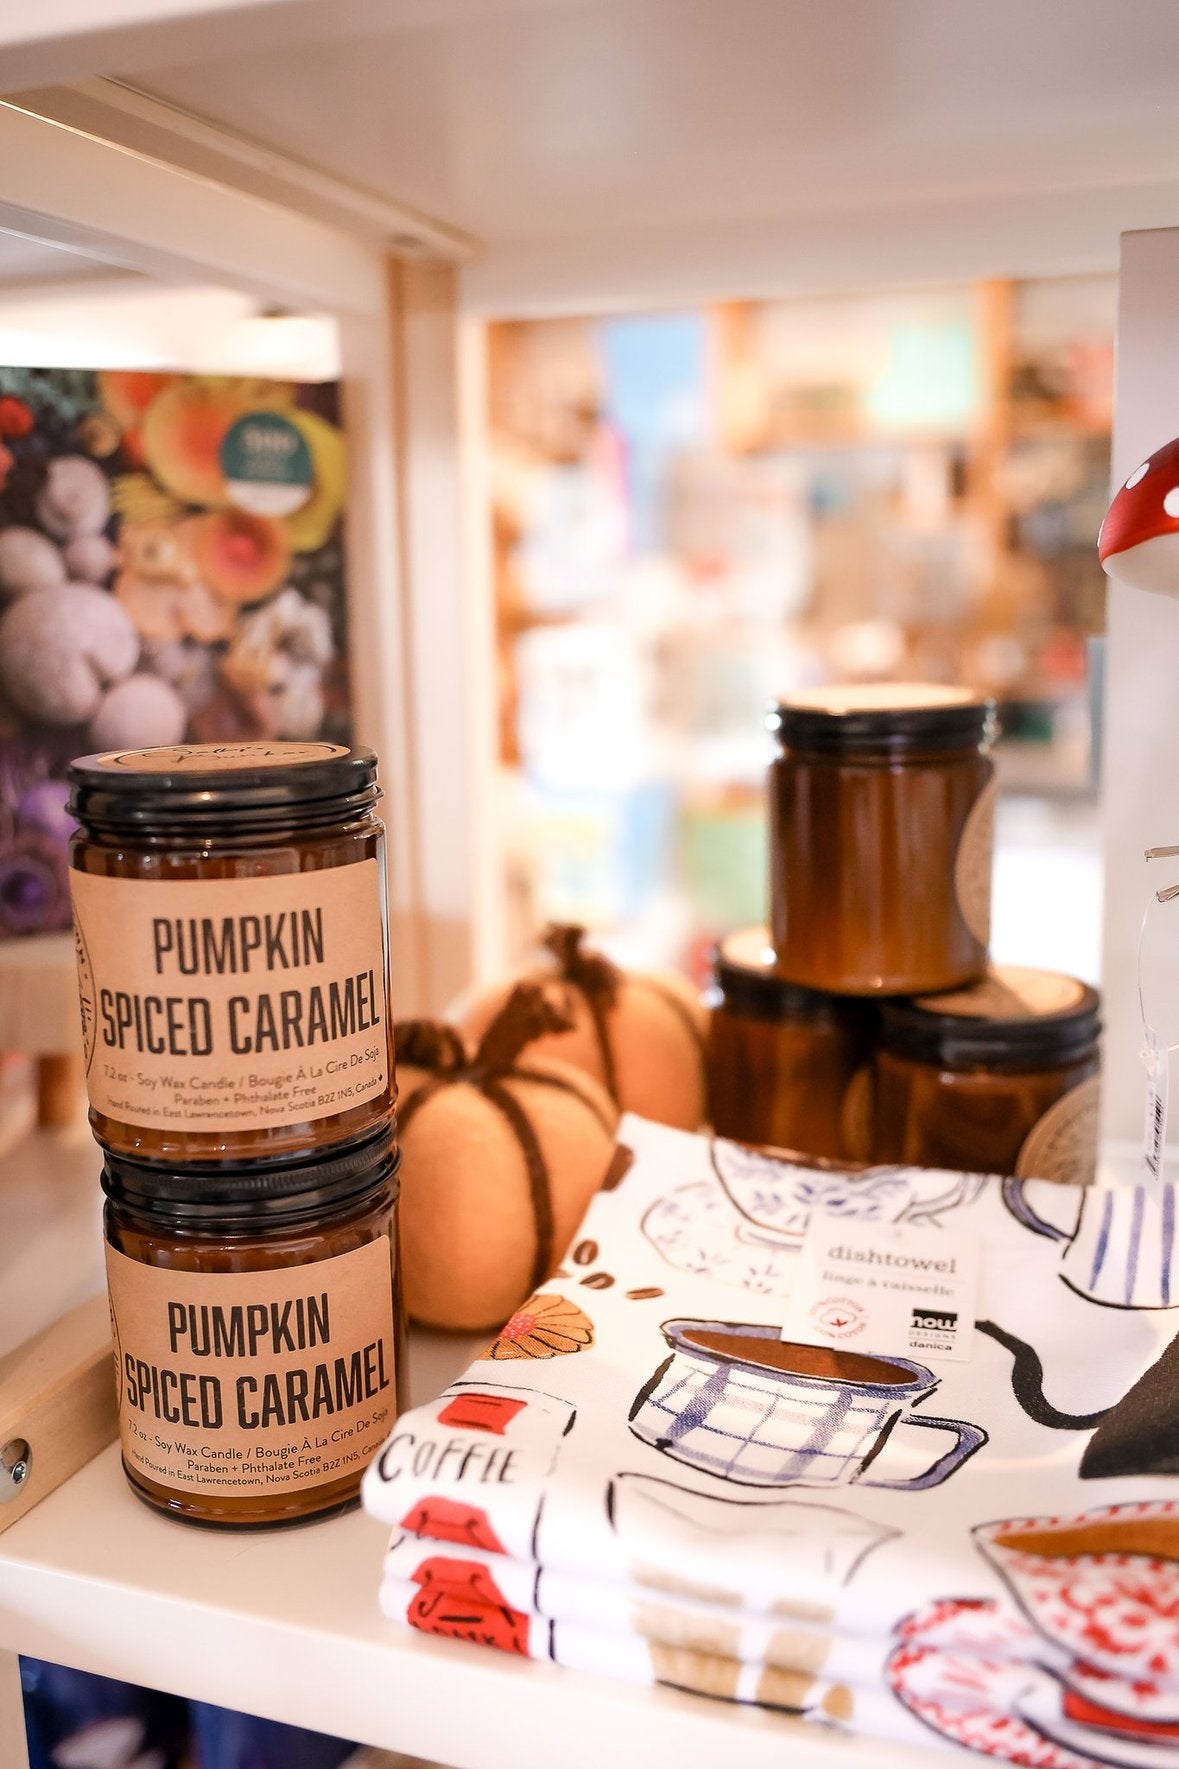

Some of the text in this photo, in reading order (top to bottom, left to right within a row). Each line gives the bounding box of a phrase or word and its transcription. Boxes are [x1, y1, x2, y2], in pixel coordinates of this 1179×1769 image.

[153, 908, 324, 975] PUMPKIN
[100, 988, 214, 1056] SPICED
[229, 969, 380, 1054] CARAMEL
[137, 1072, 156, 1090] Soy
[160, 1076, 185, 1089] Wax
[190, 1076, 235, 1090] Candle
[249, 1074, 292, 1089] Bougie
[296, 1065, 306, 1079] À
[310, 1067, 323, 1078] La
[326, 1060, 347, 1074] Cire
[351, 1054, 363, 1067] De
[365, 1046, 379, 1062] Soja
[125, 1102, 151, 1115] Poured
[163, 1107, 181, 1118] East
[260, 1106, 285, 1115] Nova
[288, 1099, 316, 1112] Scotia
[318, 1092, 335, 1106] B2Z
[337, 1087, 355, 1100] 1N5,
[355, 1077, 377, 1093] Canada
[174, 1093, 220, 1106] Paraben
[234, 1091, 289, 1104] Phthalate
[293, 1085, 317, 1098] Free
[828, 1246, 956, 1274] dishtowel
[168, 1292, 330, 1357] PUMPKIN
[911, 1316, 959, 1330] now
[909, 1341, 952, 1351] danica
[124, 1338, 390, 1430] SPICED CARAMEL
[139, 1431, 147, 1441] oz
[154, 1435, 173, 1454] Soy
[175, 1441, 198, 1457] Wax
[200, 1446, 243, 1460] Candle
[255, 1444, 298, 1460] Bougie
[301, 1436, 312, 1452] À
[315, 1436, 328, 1449] La
[331, 1428, 354, 1443] Cire
[356, 1420, 371, 1433] De
[372, 1408, 389, 1423] Soja
[145, 1457, 167, 1474] Poured
[168, 1469, 176, 1478] in
[177, 1470, 194, 1482] East
[196, 1474, 264, 1486] Lawrencetown,
[266, 1473, 290, 1484] Nova
[292, 1466, 320, 1479] Scotia
[322, 1460, 340, 1472] B2Z
[342, 1452, 360, 1465] 1N5,
[187, 1460, 229, 1473] Paraben
[242, 1460, 295, 1474] Phthalate
[298, 1455, 322, 1467] Free
